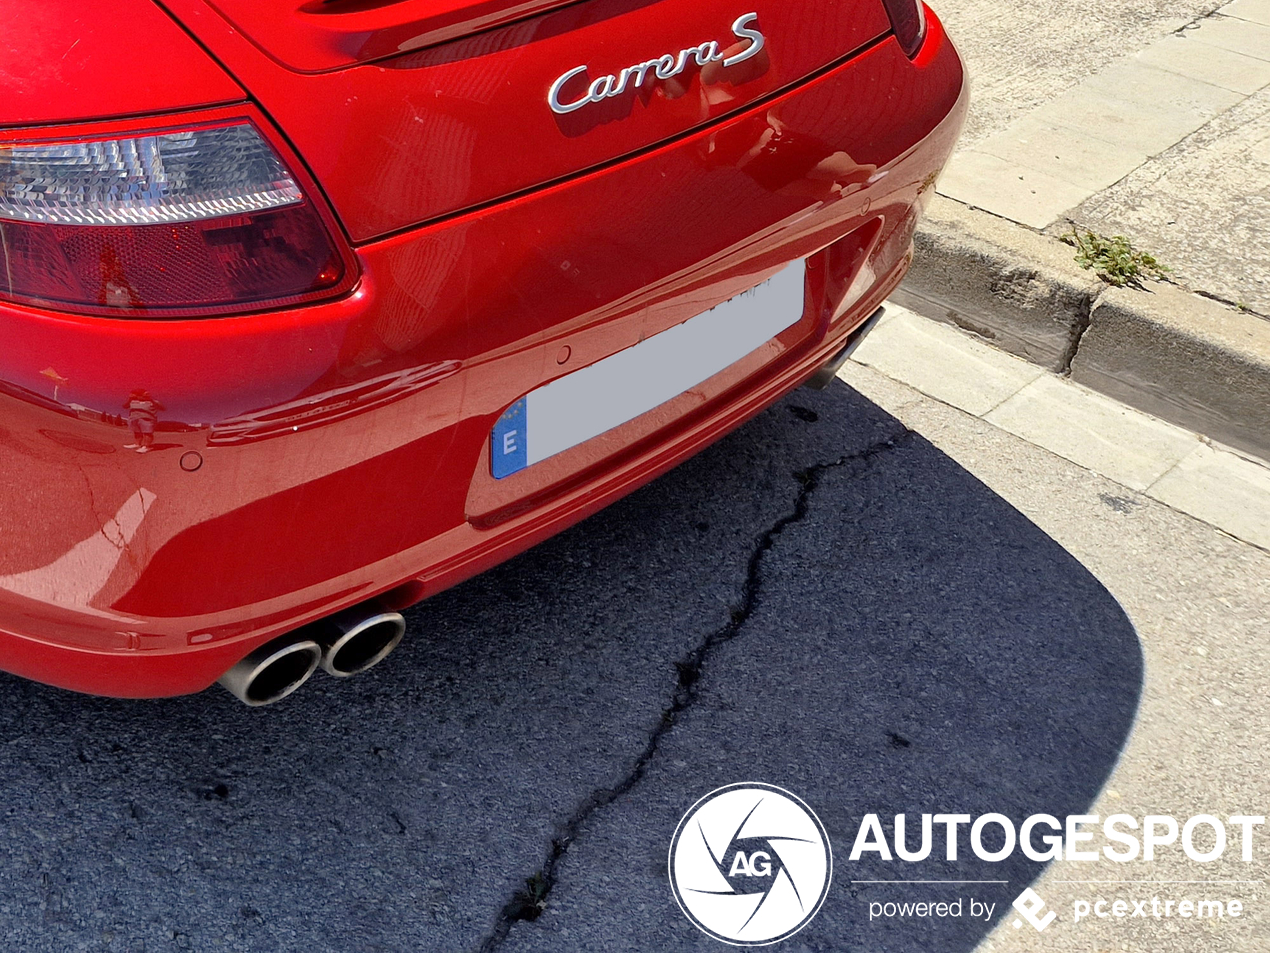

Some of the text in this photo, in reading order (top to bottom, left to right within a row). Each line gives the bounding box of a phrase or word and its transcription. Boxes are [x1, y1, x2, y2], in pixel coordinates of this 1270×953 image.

[548, 11, 764, 114] Carrera S
[503, 429, 518, 455] E
